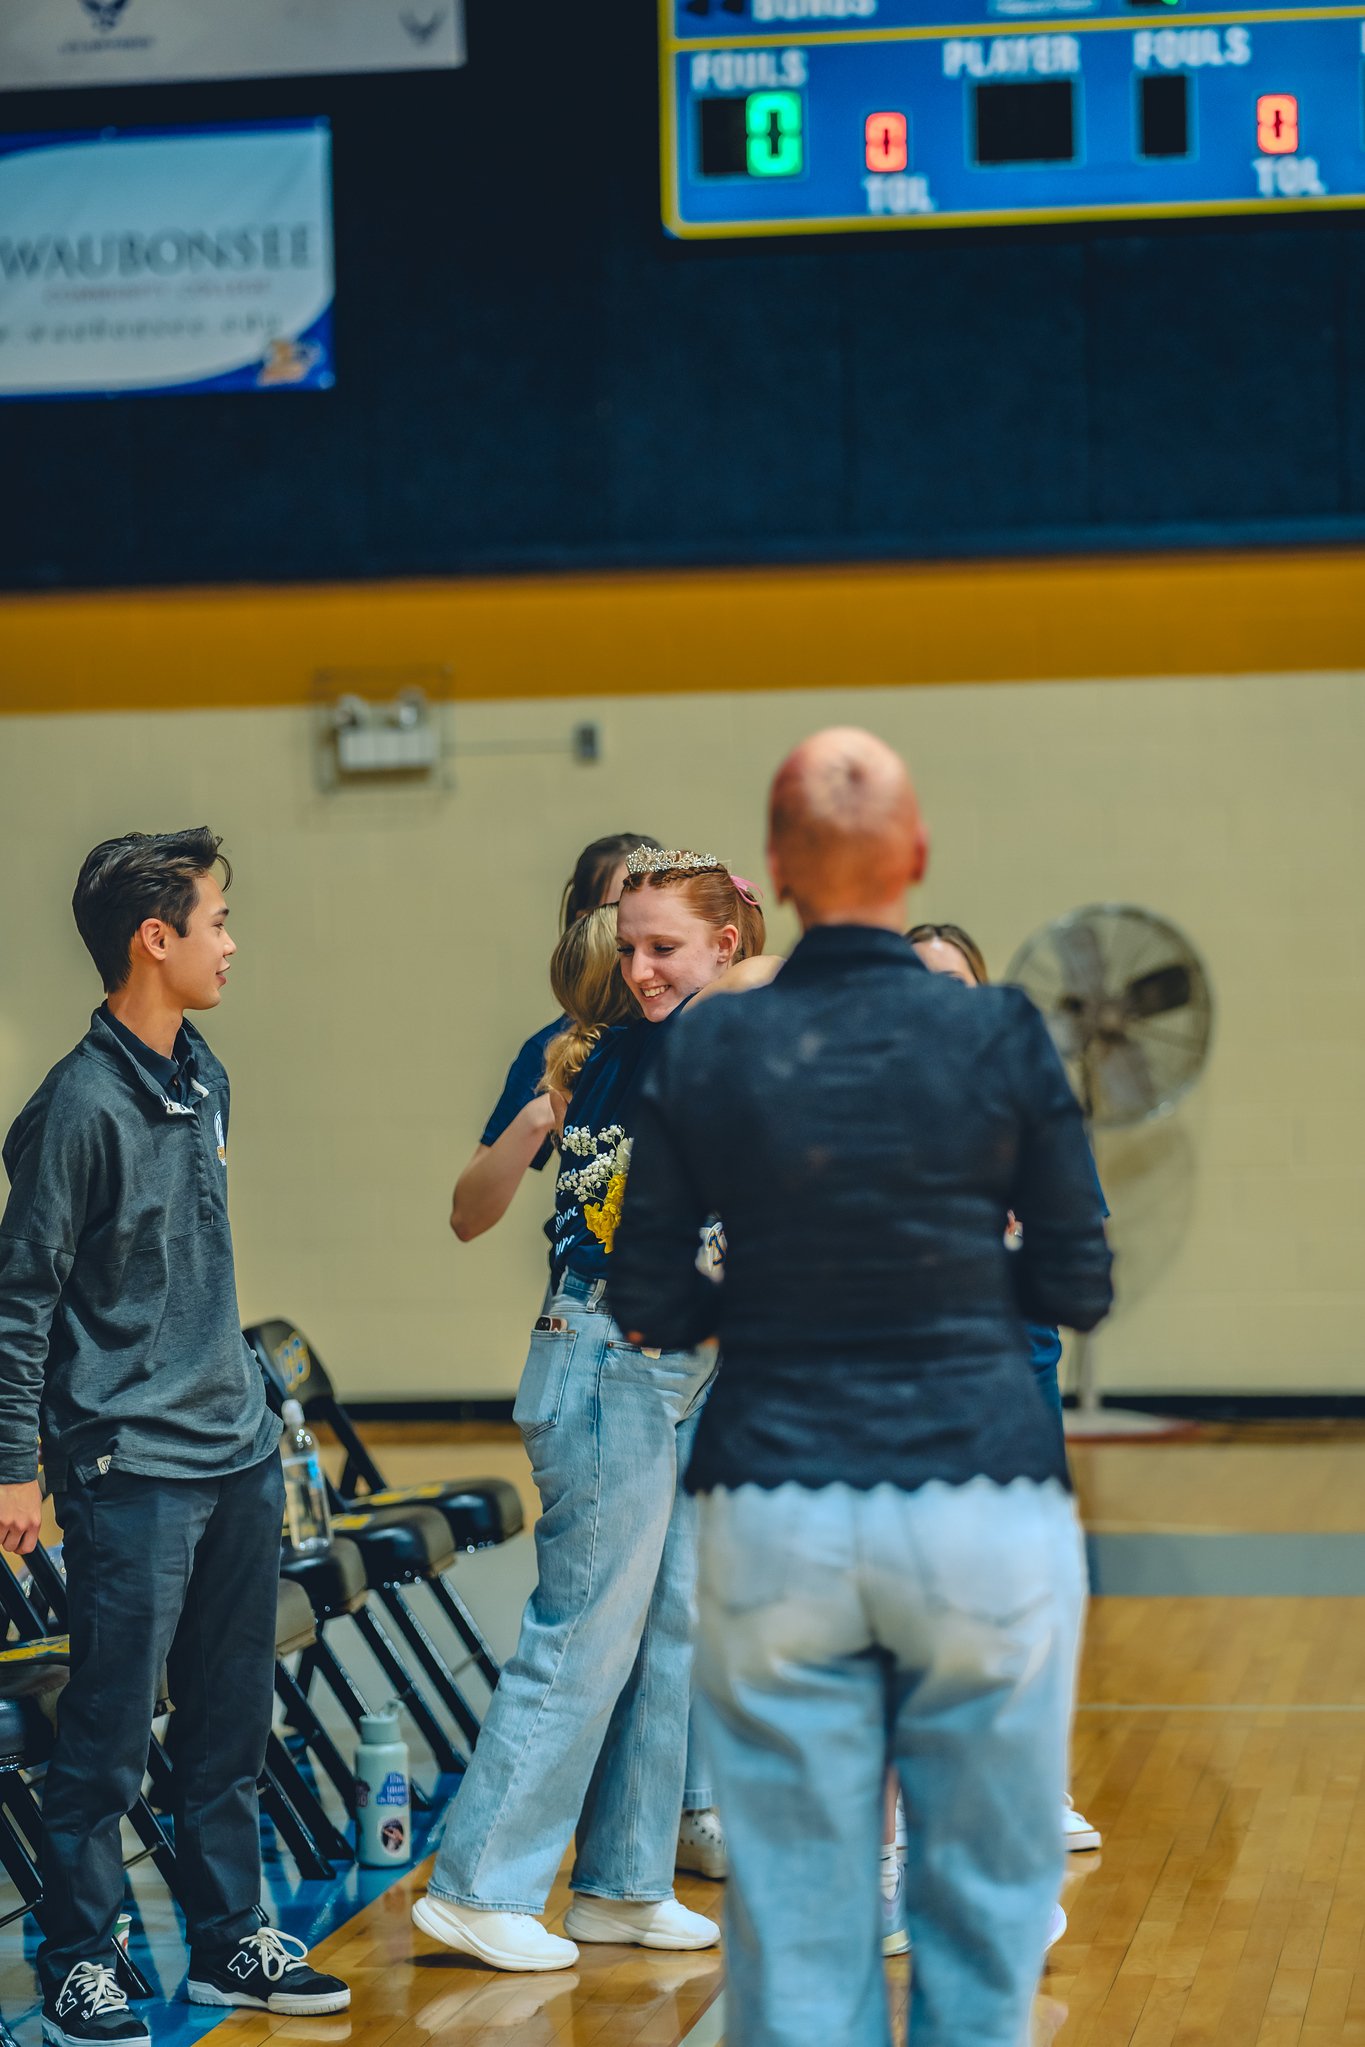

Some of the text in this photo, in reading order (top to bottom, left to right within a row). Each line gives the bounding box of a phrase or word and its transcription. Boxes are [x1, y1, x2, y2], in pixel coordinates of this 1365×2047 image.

[691, 49, 806, 91] FOULS
[942, 35, 1081, 78] PLAYER
[1133, 27, 1252, 70] FOULS
[746, 90, 802, 177] 0
[865, 111, 907, 172] 0
[1257, 94, 1299, 154] 0
[0, 224, 313, 280] WAUBONSEE
